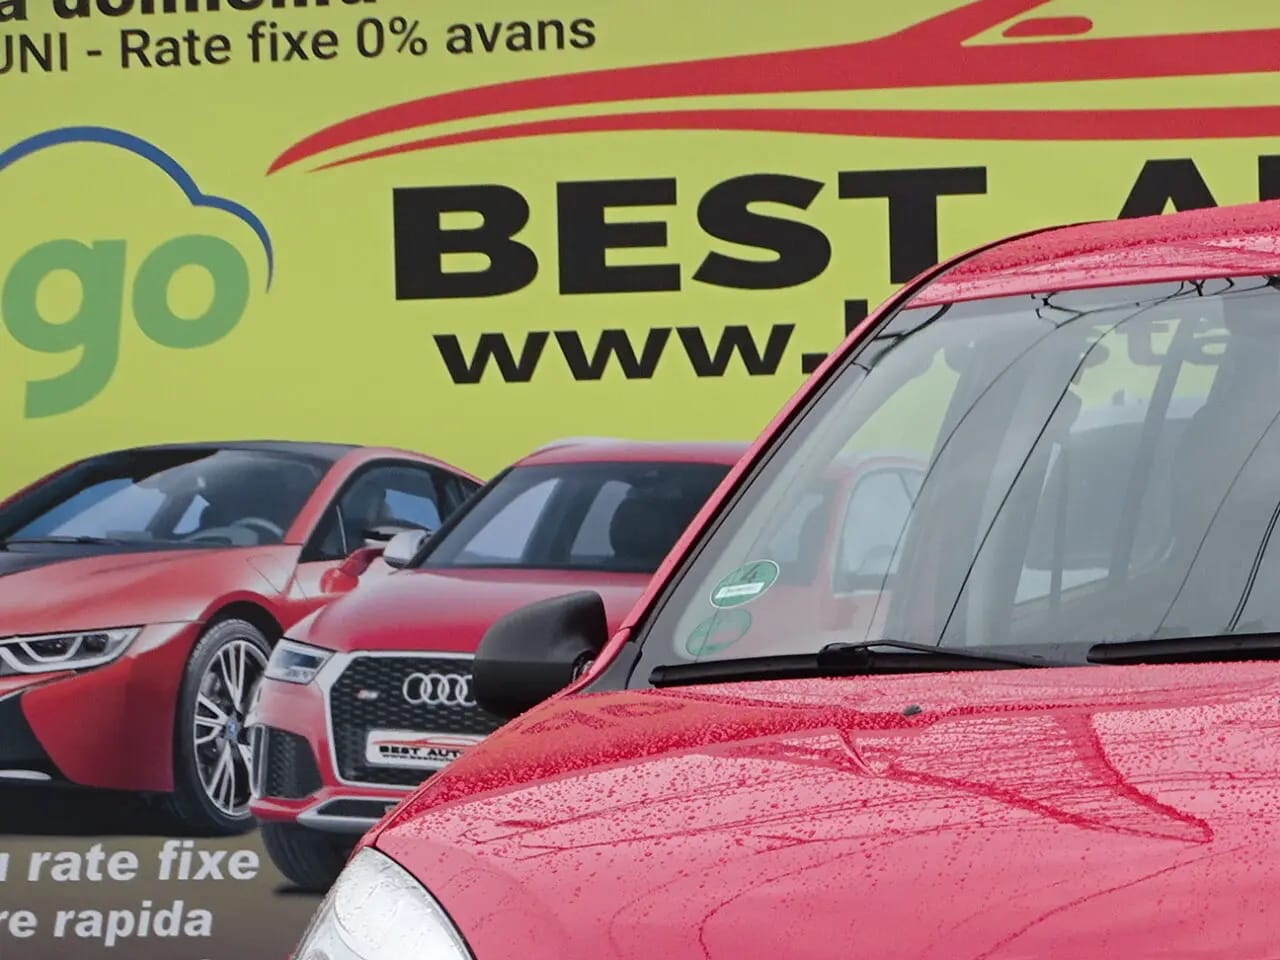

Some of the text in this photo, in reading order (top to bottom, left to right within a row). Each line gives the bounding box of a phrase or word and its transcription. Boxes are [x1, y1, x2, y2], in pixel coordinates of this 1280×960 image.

[120, 28, 231, 68] Rate
[248, 20, 338, 63] fixe
[356, 16, 428, 58] 0%
[446, 18, 596, 54] avans
[392, 166, 988, 300] BEST
[27, 841, 139, 882] rate
[157, 839, 260, 881] fixe
[53, 900, 214, 946] rapida
